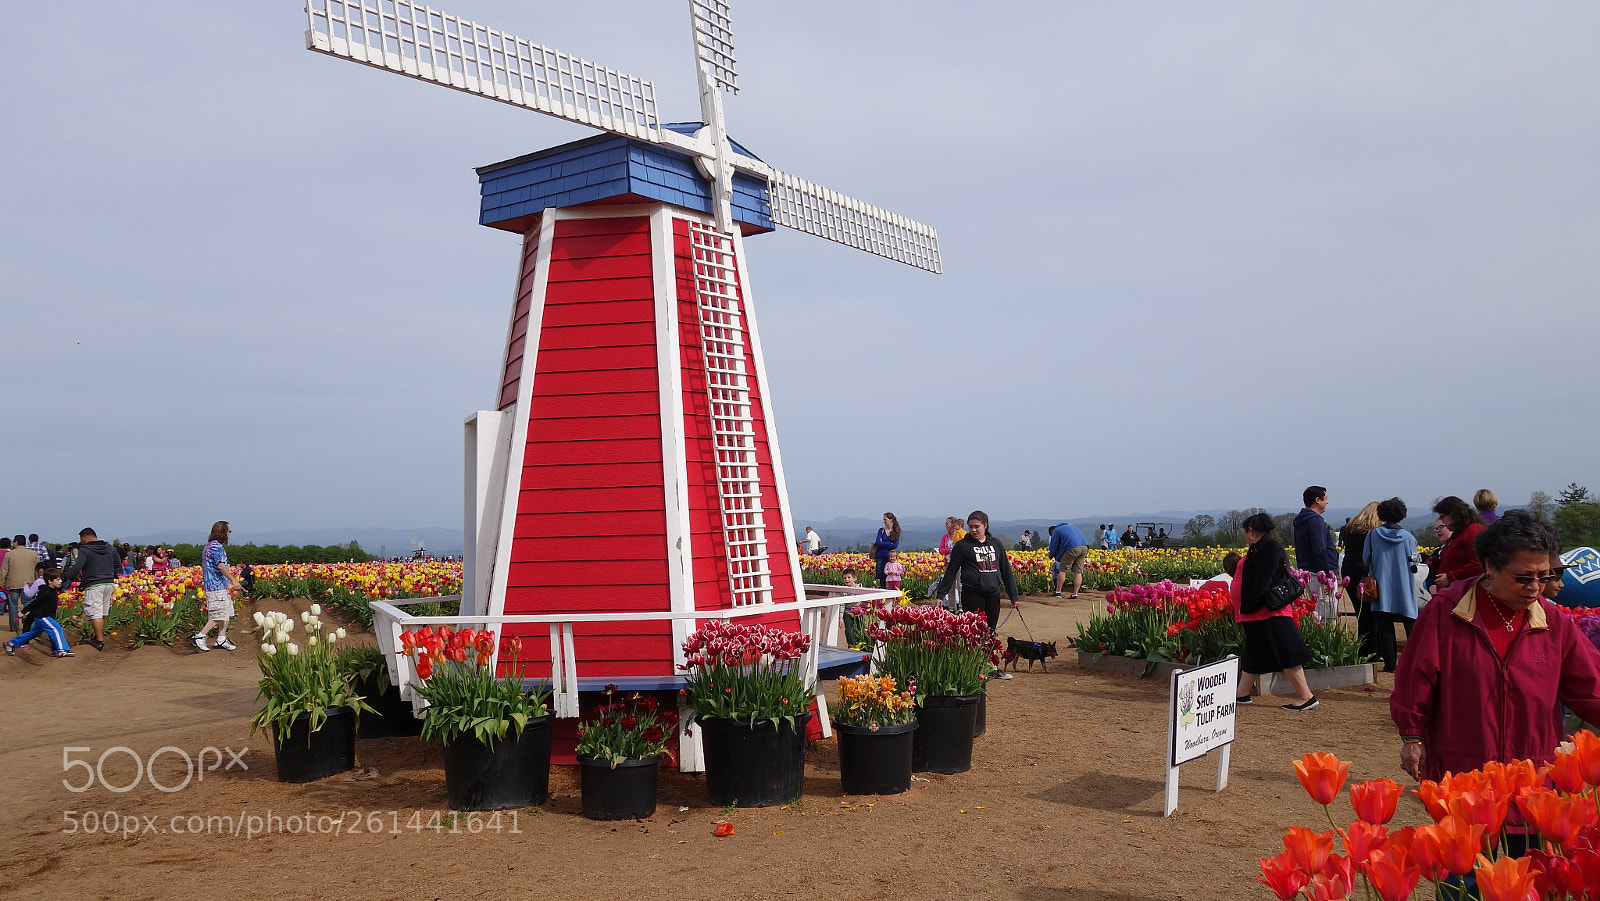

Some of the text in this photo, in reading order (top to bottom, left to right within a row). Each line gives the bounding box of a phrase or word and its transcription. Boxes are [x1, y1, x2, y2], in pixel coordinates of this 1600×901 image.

[1197, 672, 1227, 692] WOODEN
[1196, 693, 1214, 710] SHOE
[1196, 702, 1235, 727] TULIP FARM
